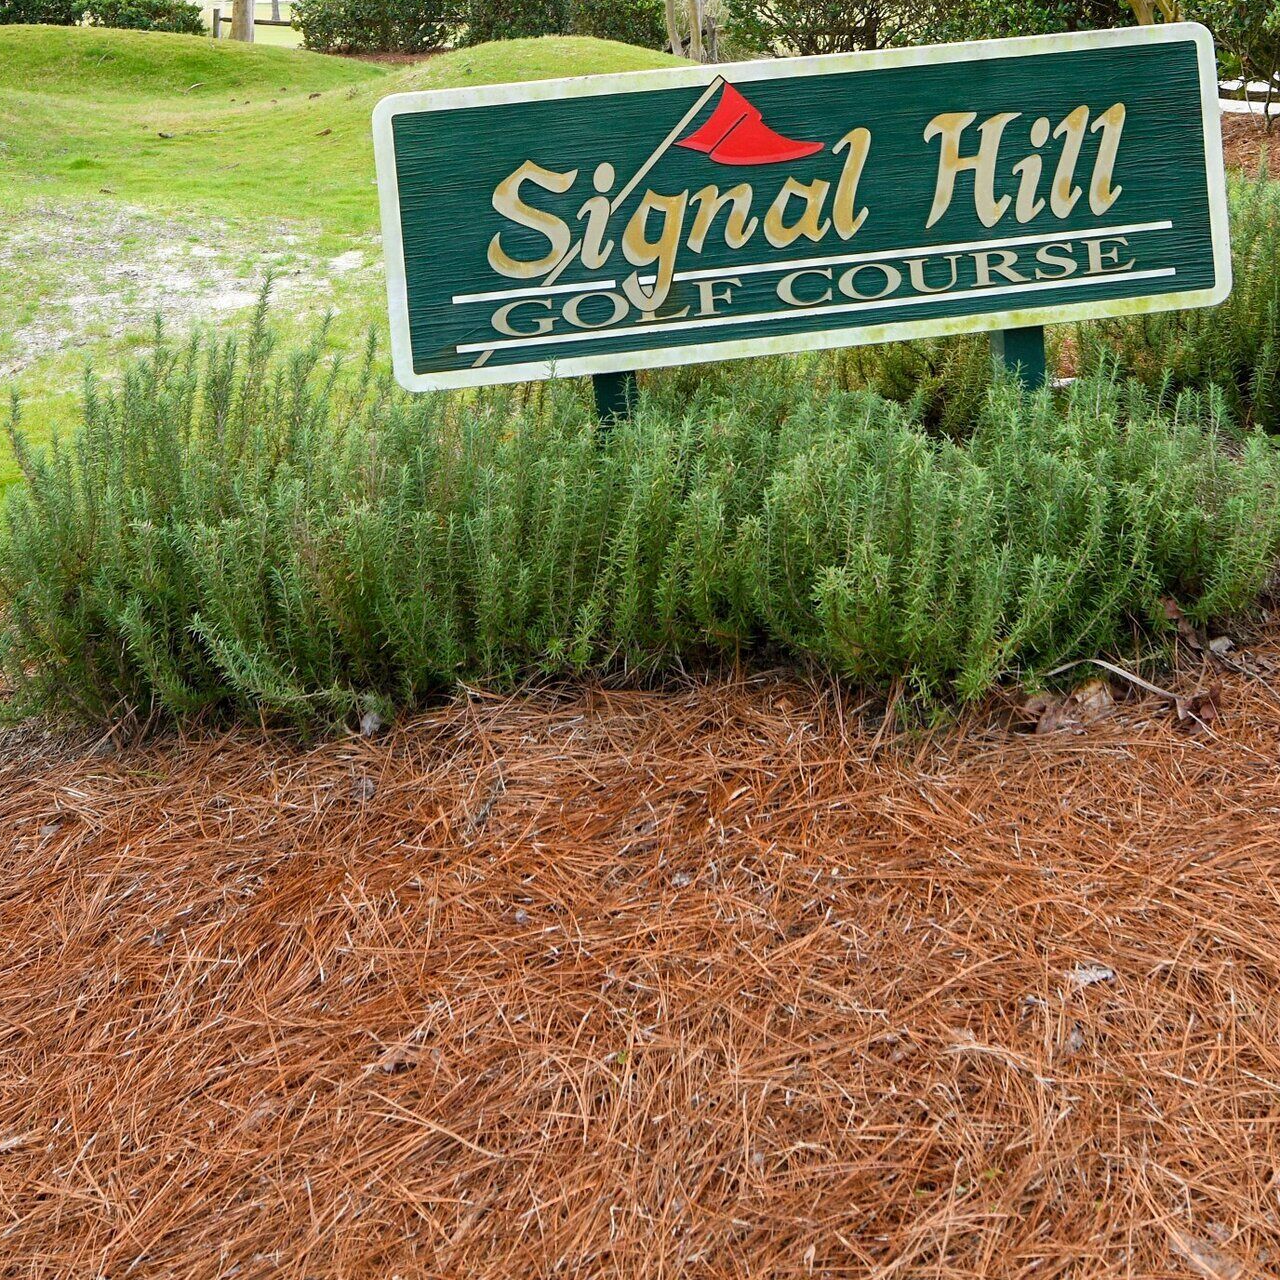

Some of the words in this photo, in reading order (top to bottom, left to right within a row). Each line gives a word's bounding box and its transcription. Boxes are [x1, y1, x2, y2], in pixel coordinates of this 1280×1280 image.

[487, 127, 872, 312] Signal
[924, 102, 1127, 230] Hill
[491, 277, 742, 337] GOLF
[777, 236, 1137, 307] COURSE
